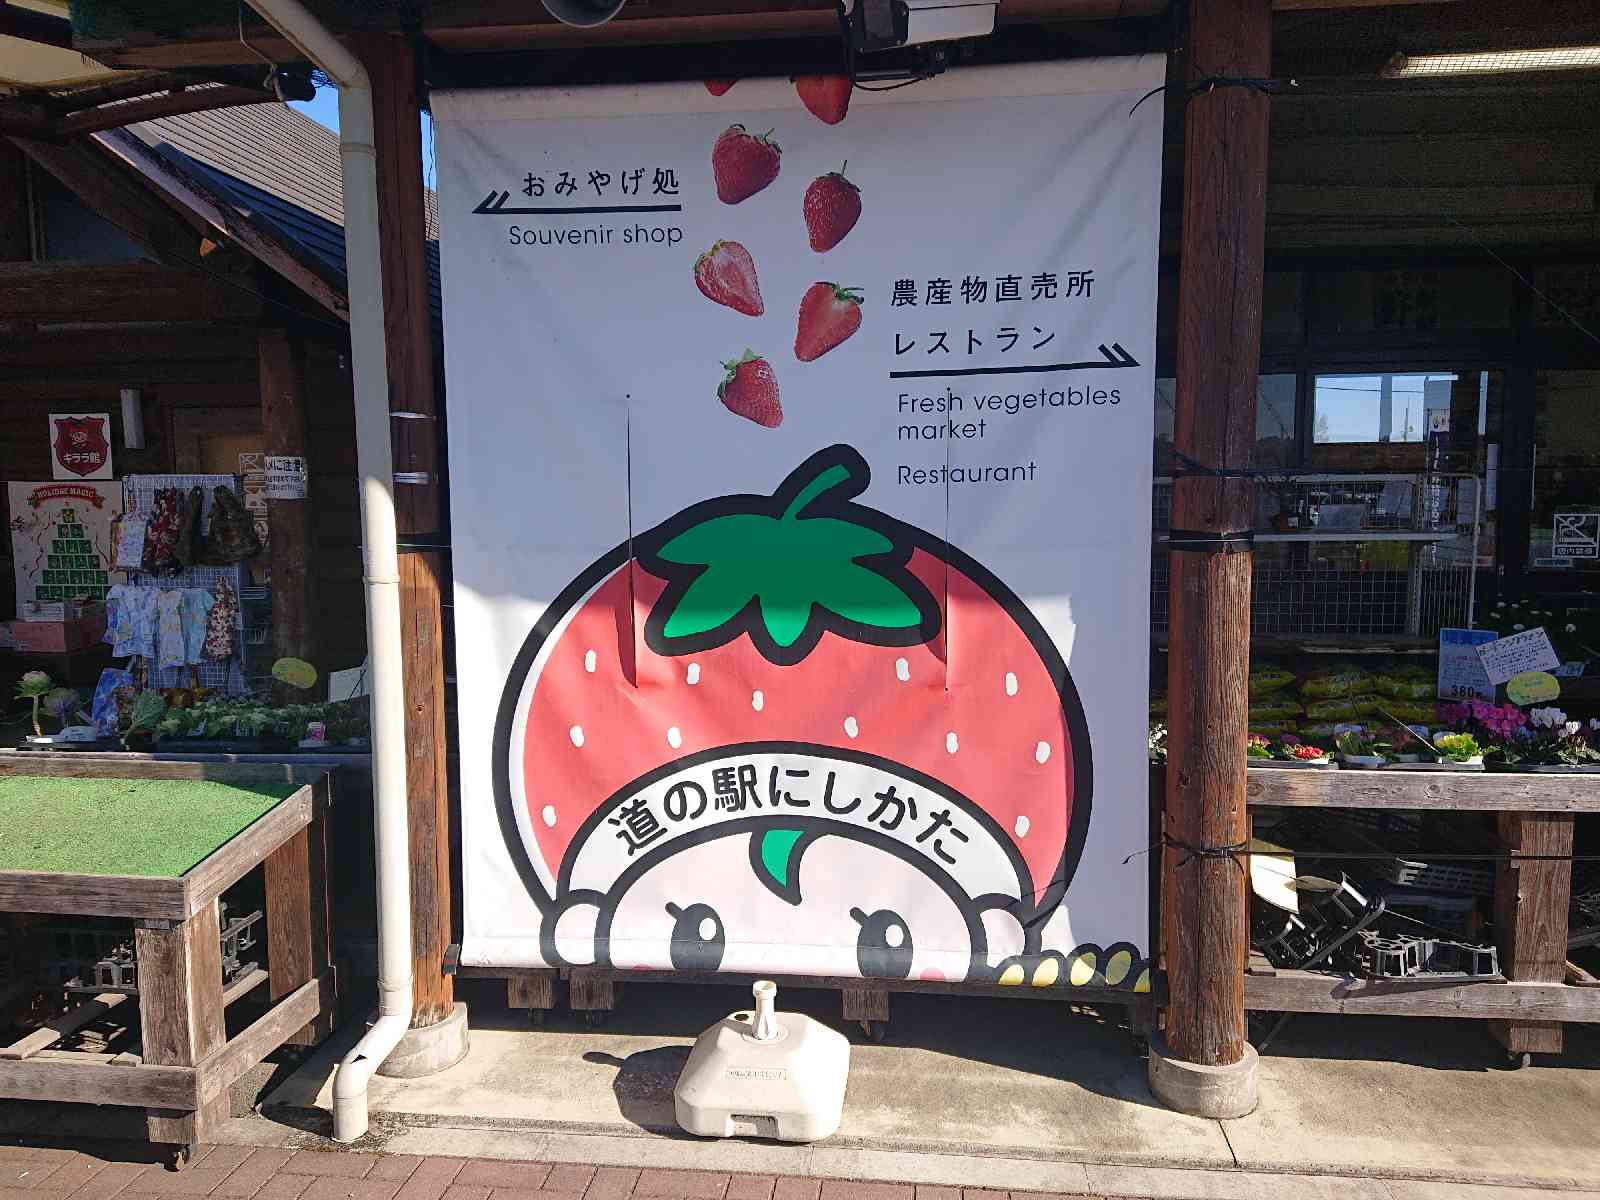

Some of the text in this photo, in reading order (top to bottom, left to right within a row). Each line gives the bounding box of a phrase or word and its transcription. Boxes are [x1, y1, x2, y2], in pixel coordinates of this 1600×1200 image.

[522, 167, 679, 197] おみやげ処
[509, 223, 683, 247] Souvenir shop
[891, 269, 1095, 308] 農産物直売所
[895, 326, 1056, 356] レストラン
[898, 385, 1121, 415] Fresh vegetables
[898, 418, 987, 441] market
[898, 461, 1036, 485] Restaurant
[608, 764, 969, 866] 道の駅にしかた
